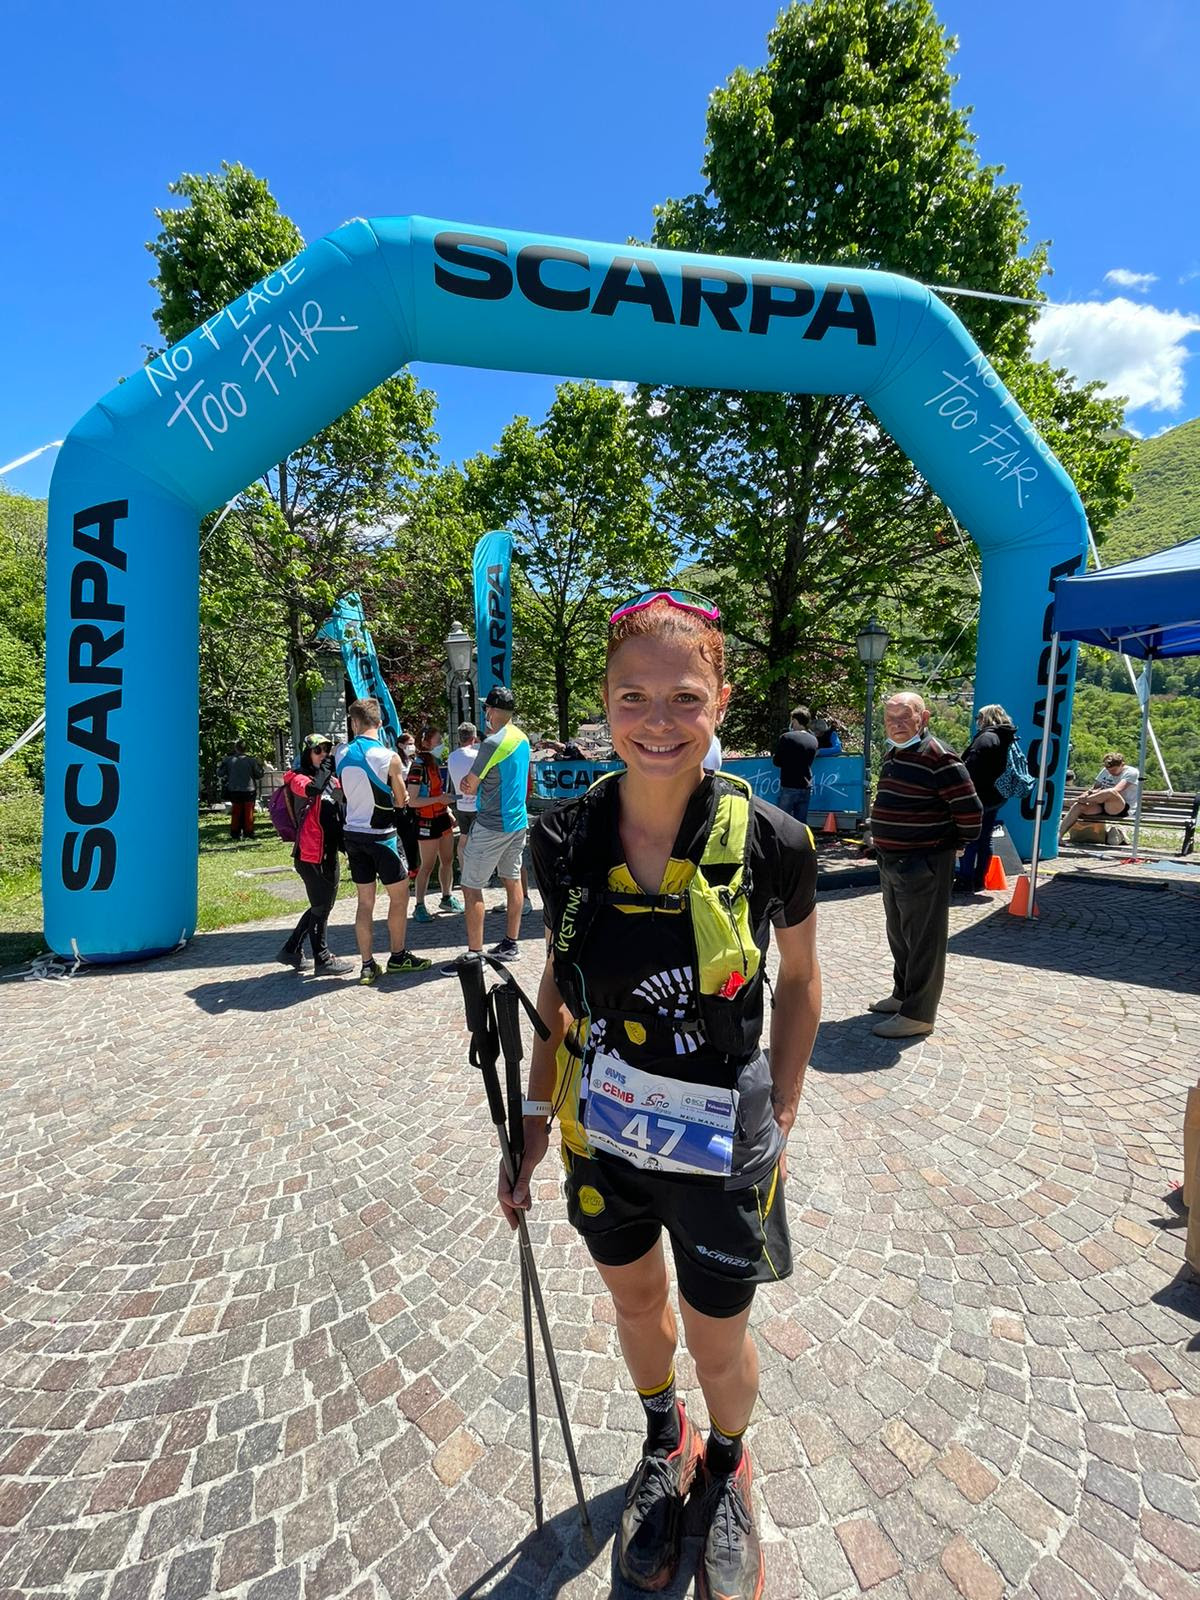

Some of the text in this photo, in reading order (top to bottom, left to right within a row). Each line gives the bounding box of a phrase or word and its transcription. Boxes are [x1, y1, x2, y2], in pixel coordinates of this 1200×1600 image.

[199, 262, 305, 350] PLACE
[433, 231, 877, 347] SCARPA
[486, 563, 507, 687] ARPA
[61, 499, 129, 891] SCARPA
[602, 1082, 635, 1104] CEMB
[621, 1113, 687, 1157] 47
